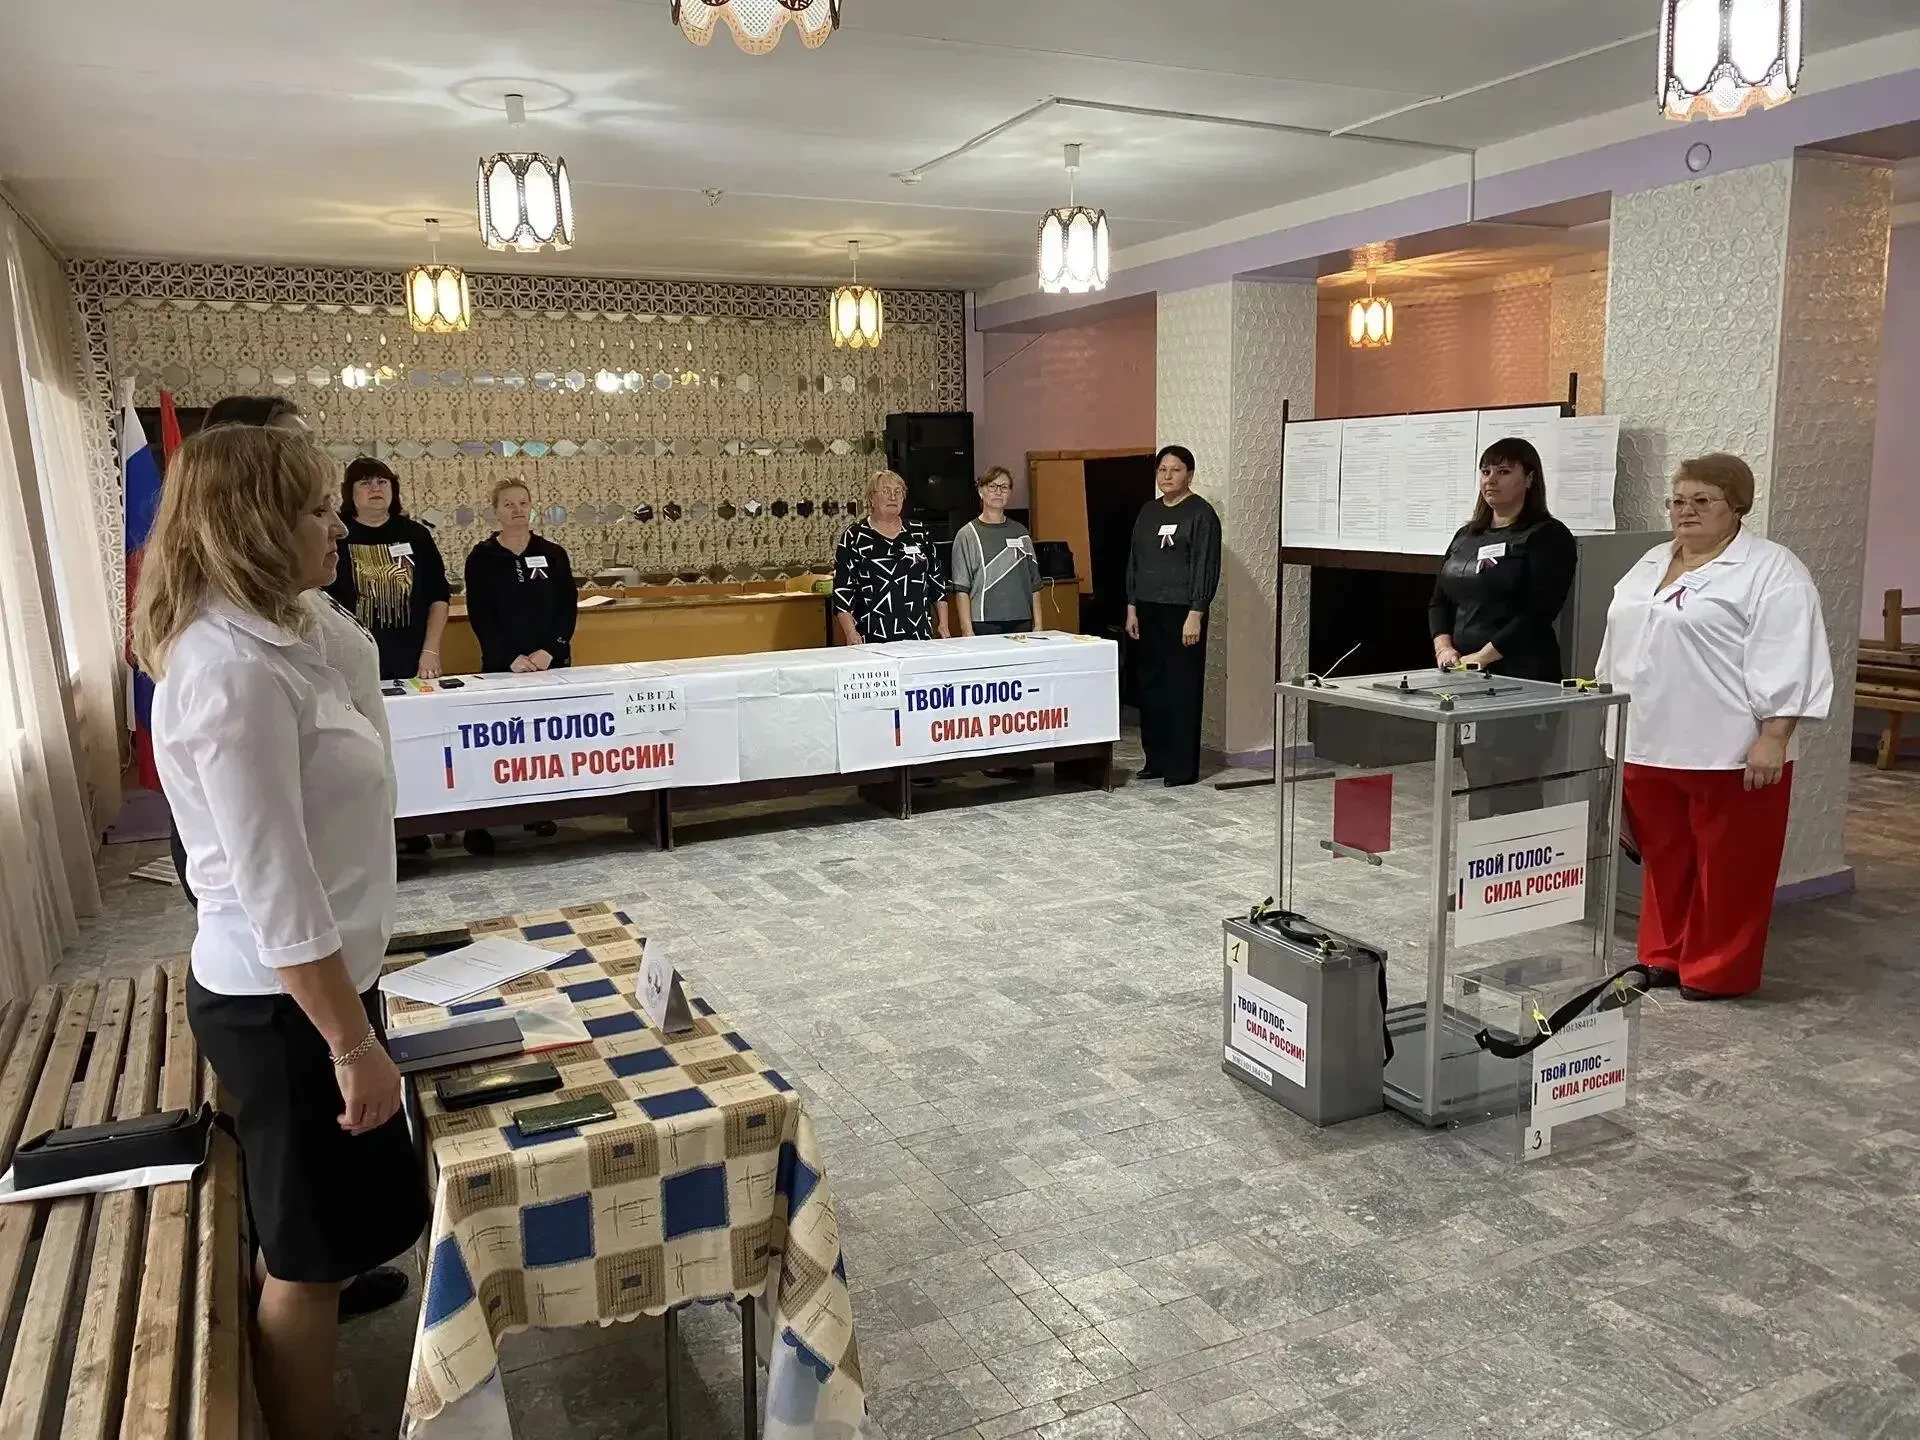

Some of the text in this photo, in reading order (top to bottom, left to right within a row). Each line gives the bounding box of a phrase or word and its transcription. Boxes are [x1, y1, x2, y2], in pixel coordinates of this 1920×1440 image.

[905, 684, 954, 711] ТВОЙ
[961, 680, 1021, 706] ГОЛОС
[458, 712, 615, 748] ТВОЙ ГОЛОС
[932, 708, 1068, 742] СИЛА РОССИИ!
[1463, 723, 1472, 740] 2
[494, 743, 673, 783] СИЛА РОССИИ!
[1468, 853, 1504, 879] ТВОЙ
[1508, 846, 1552, 872] ГОЛОС
[1485, 867, 1584, 904] СИЛА РОССИИ!
[1232, 942, 1241, 963] 1
[1238, 995, 1256, 1016] ТВОЙ
[1259, 1008, 1284, 1031] ГОЛОС
[1247, 1019, 1304, 1062] СИЛА РОССИИ!
[1541, 1063, 1566, 1083] ТВОЙ
[1569, 1055, 1601, 1075] ГОЛОС
[1553, 1068, 1625, 1100] СИЛА РОССИИ!
[1532, 1130, 1542, 1150] 3
